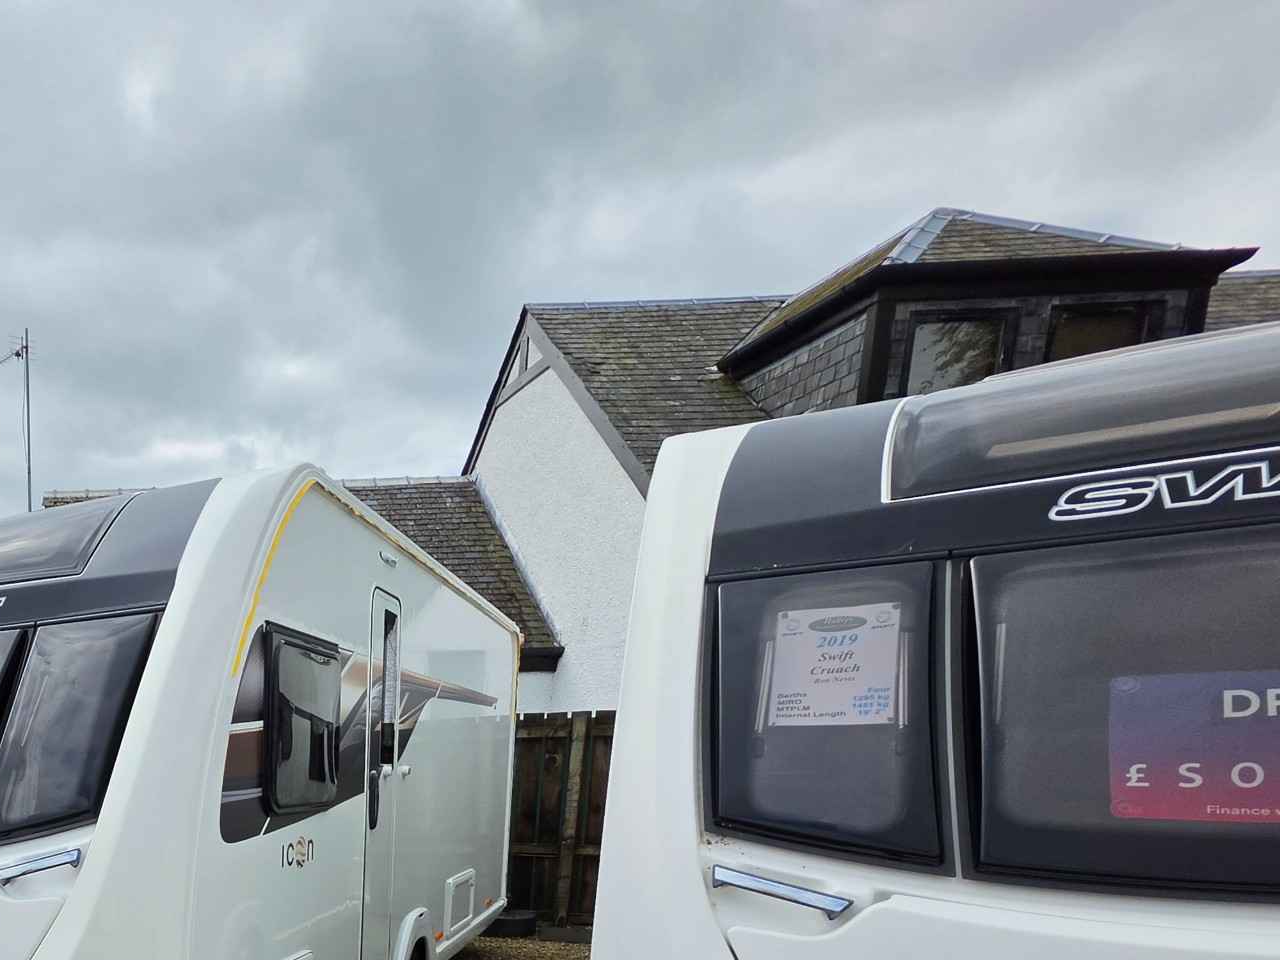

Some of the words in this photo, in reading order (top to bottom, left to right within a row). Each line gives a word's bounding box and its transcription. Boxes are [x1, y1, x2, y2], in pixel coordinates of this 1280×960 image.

[817, 633, 859, 648] 2019
[818, 650, 854, 663] Swift
[810, 663, 861, 676] Cruach
[813, 710, 847, 718] Length
[1206, 805, 1271, 816] Finance
